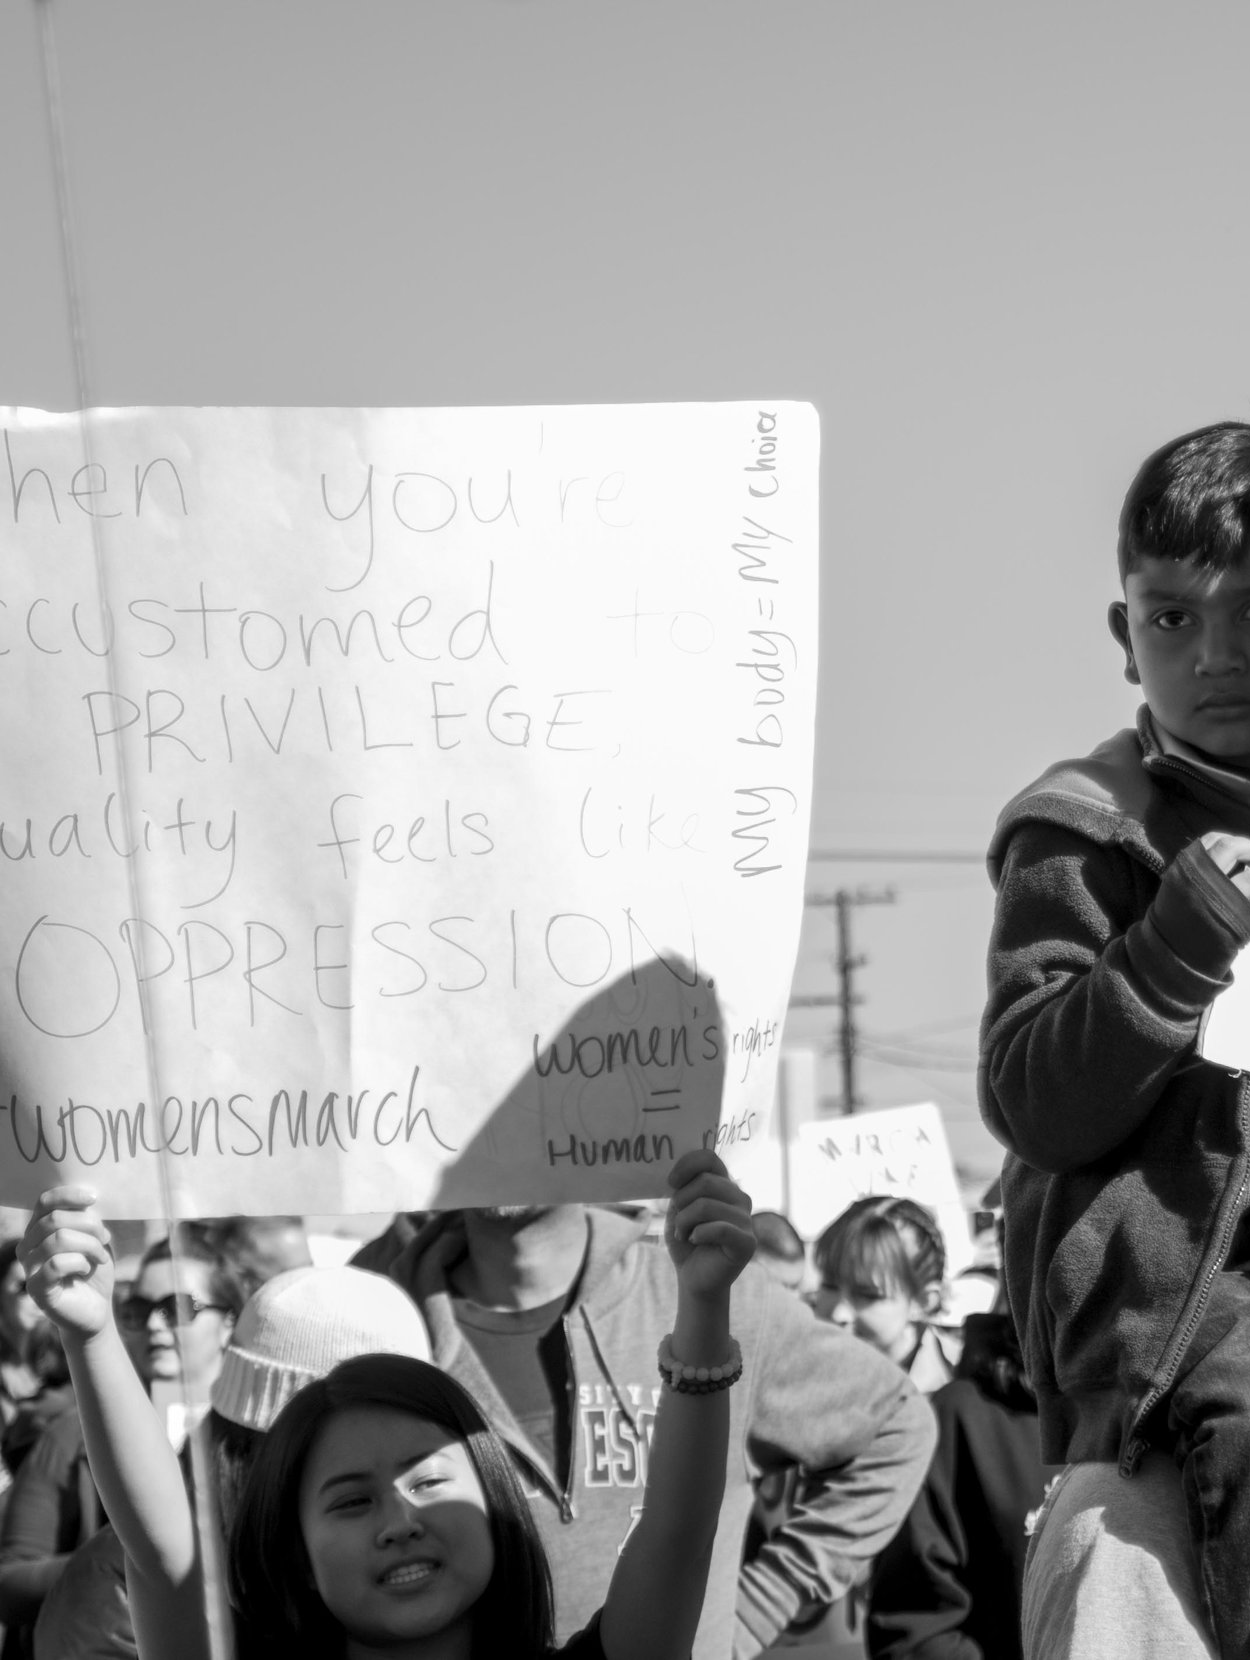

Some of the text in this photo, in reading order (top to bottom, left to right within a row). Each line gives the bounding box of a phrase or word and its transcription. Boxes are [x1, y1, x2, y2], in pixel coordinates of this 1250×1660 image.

[321, 422, 635, 592] you're
[730, 515, 794, 585] My
[0, 559, 715, 671] customed to
[735, 630, 798, 748] body
[316, 794, 496, 879] feels
[579, 786, 709, 860] like
[731, 786, 798, 879] My
[15, 880, 717, 1039] OPPRESSION.
[732, 1017, 779, 1084] rights
[0, 1065, 459, 1167] womensmarch
